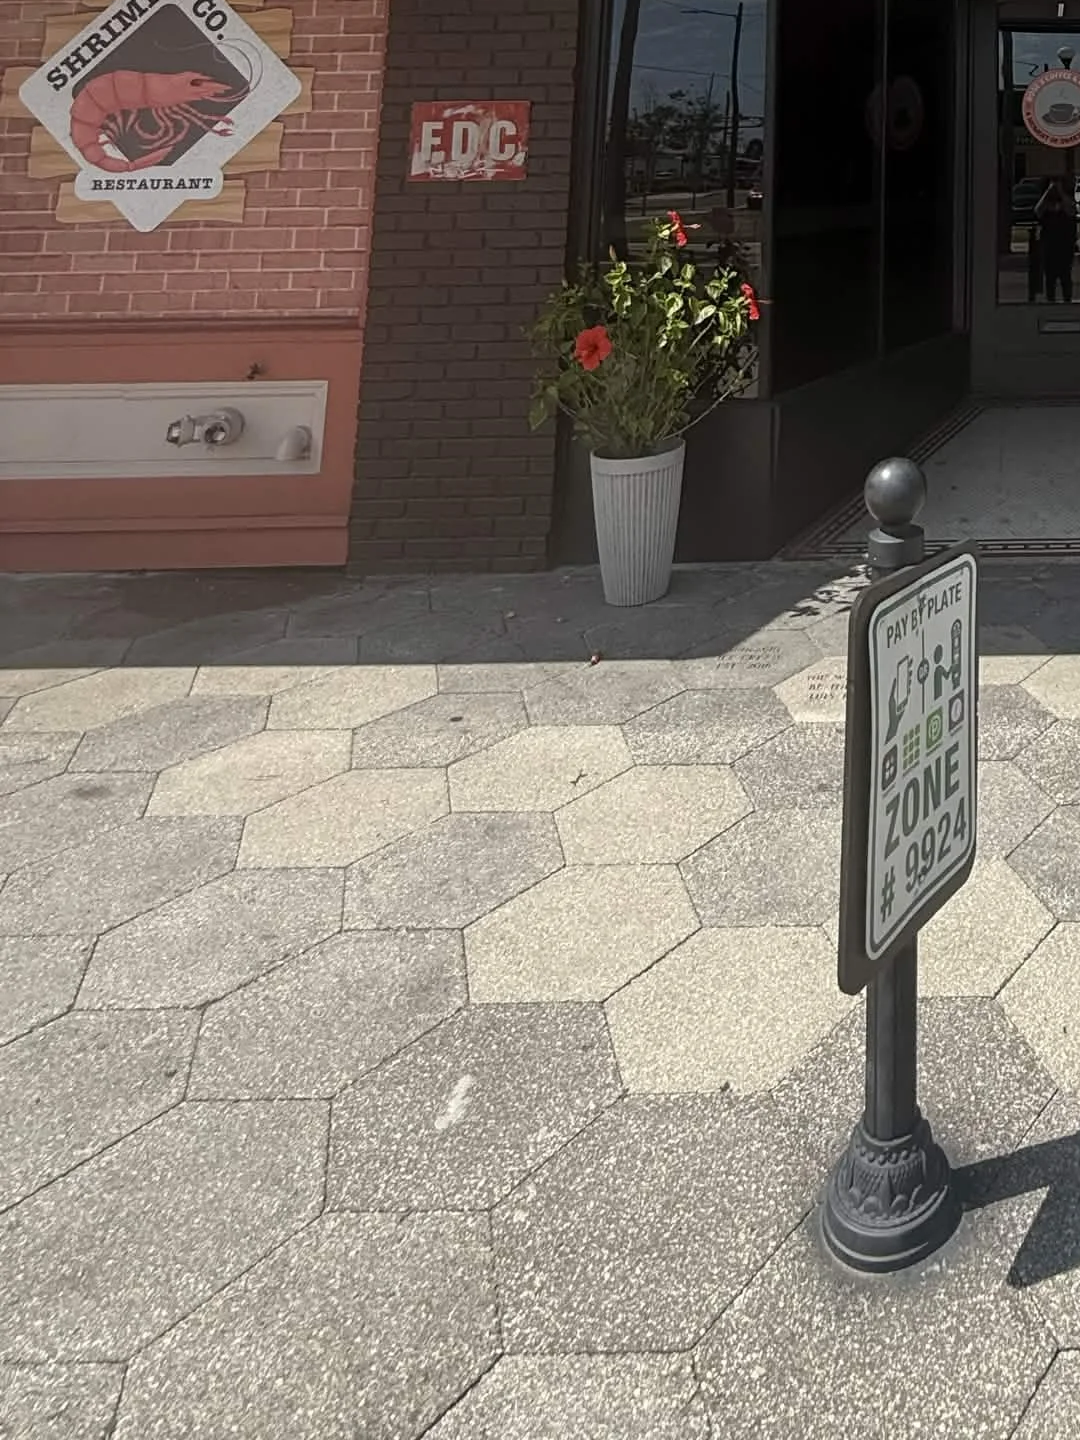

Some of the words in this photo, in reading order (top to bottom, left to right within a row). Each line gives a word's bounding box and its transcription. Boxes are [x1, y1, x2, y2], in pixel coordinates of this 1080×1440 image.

[91, 178, 213, 191] RESTAURANT
[887, 614, 908, 648] PAY
[911, 603, 926, 630] BY
[928, 582, 962, 618] PLATE
[885, 741, 960, 860] ZONE
[881, 866, 896, 923] #
[905, 797, 967, 893] 9924
